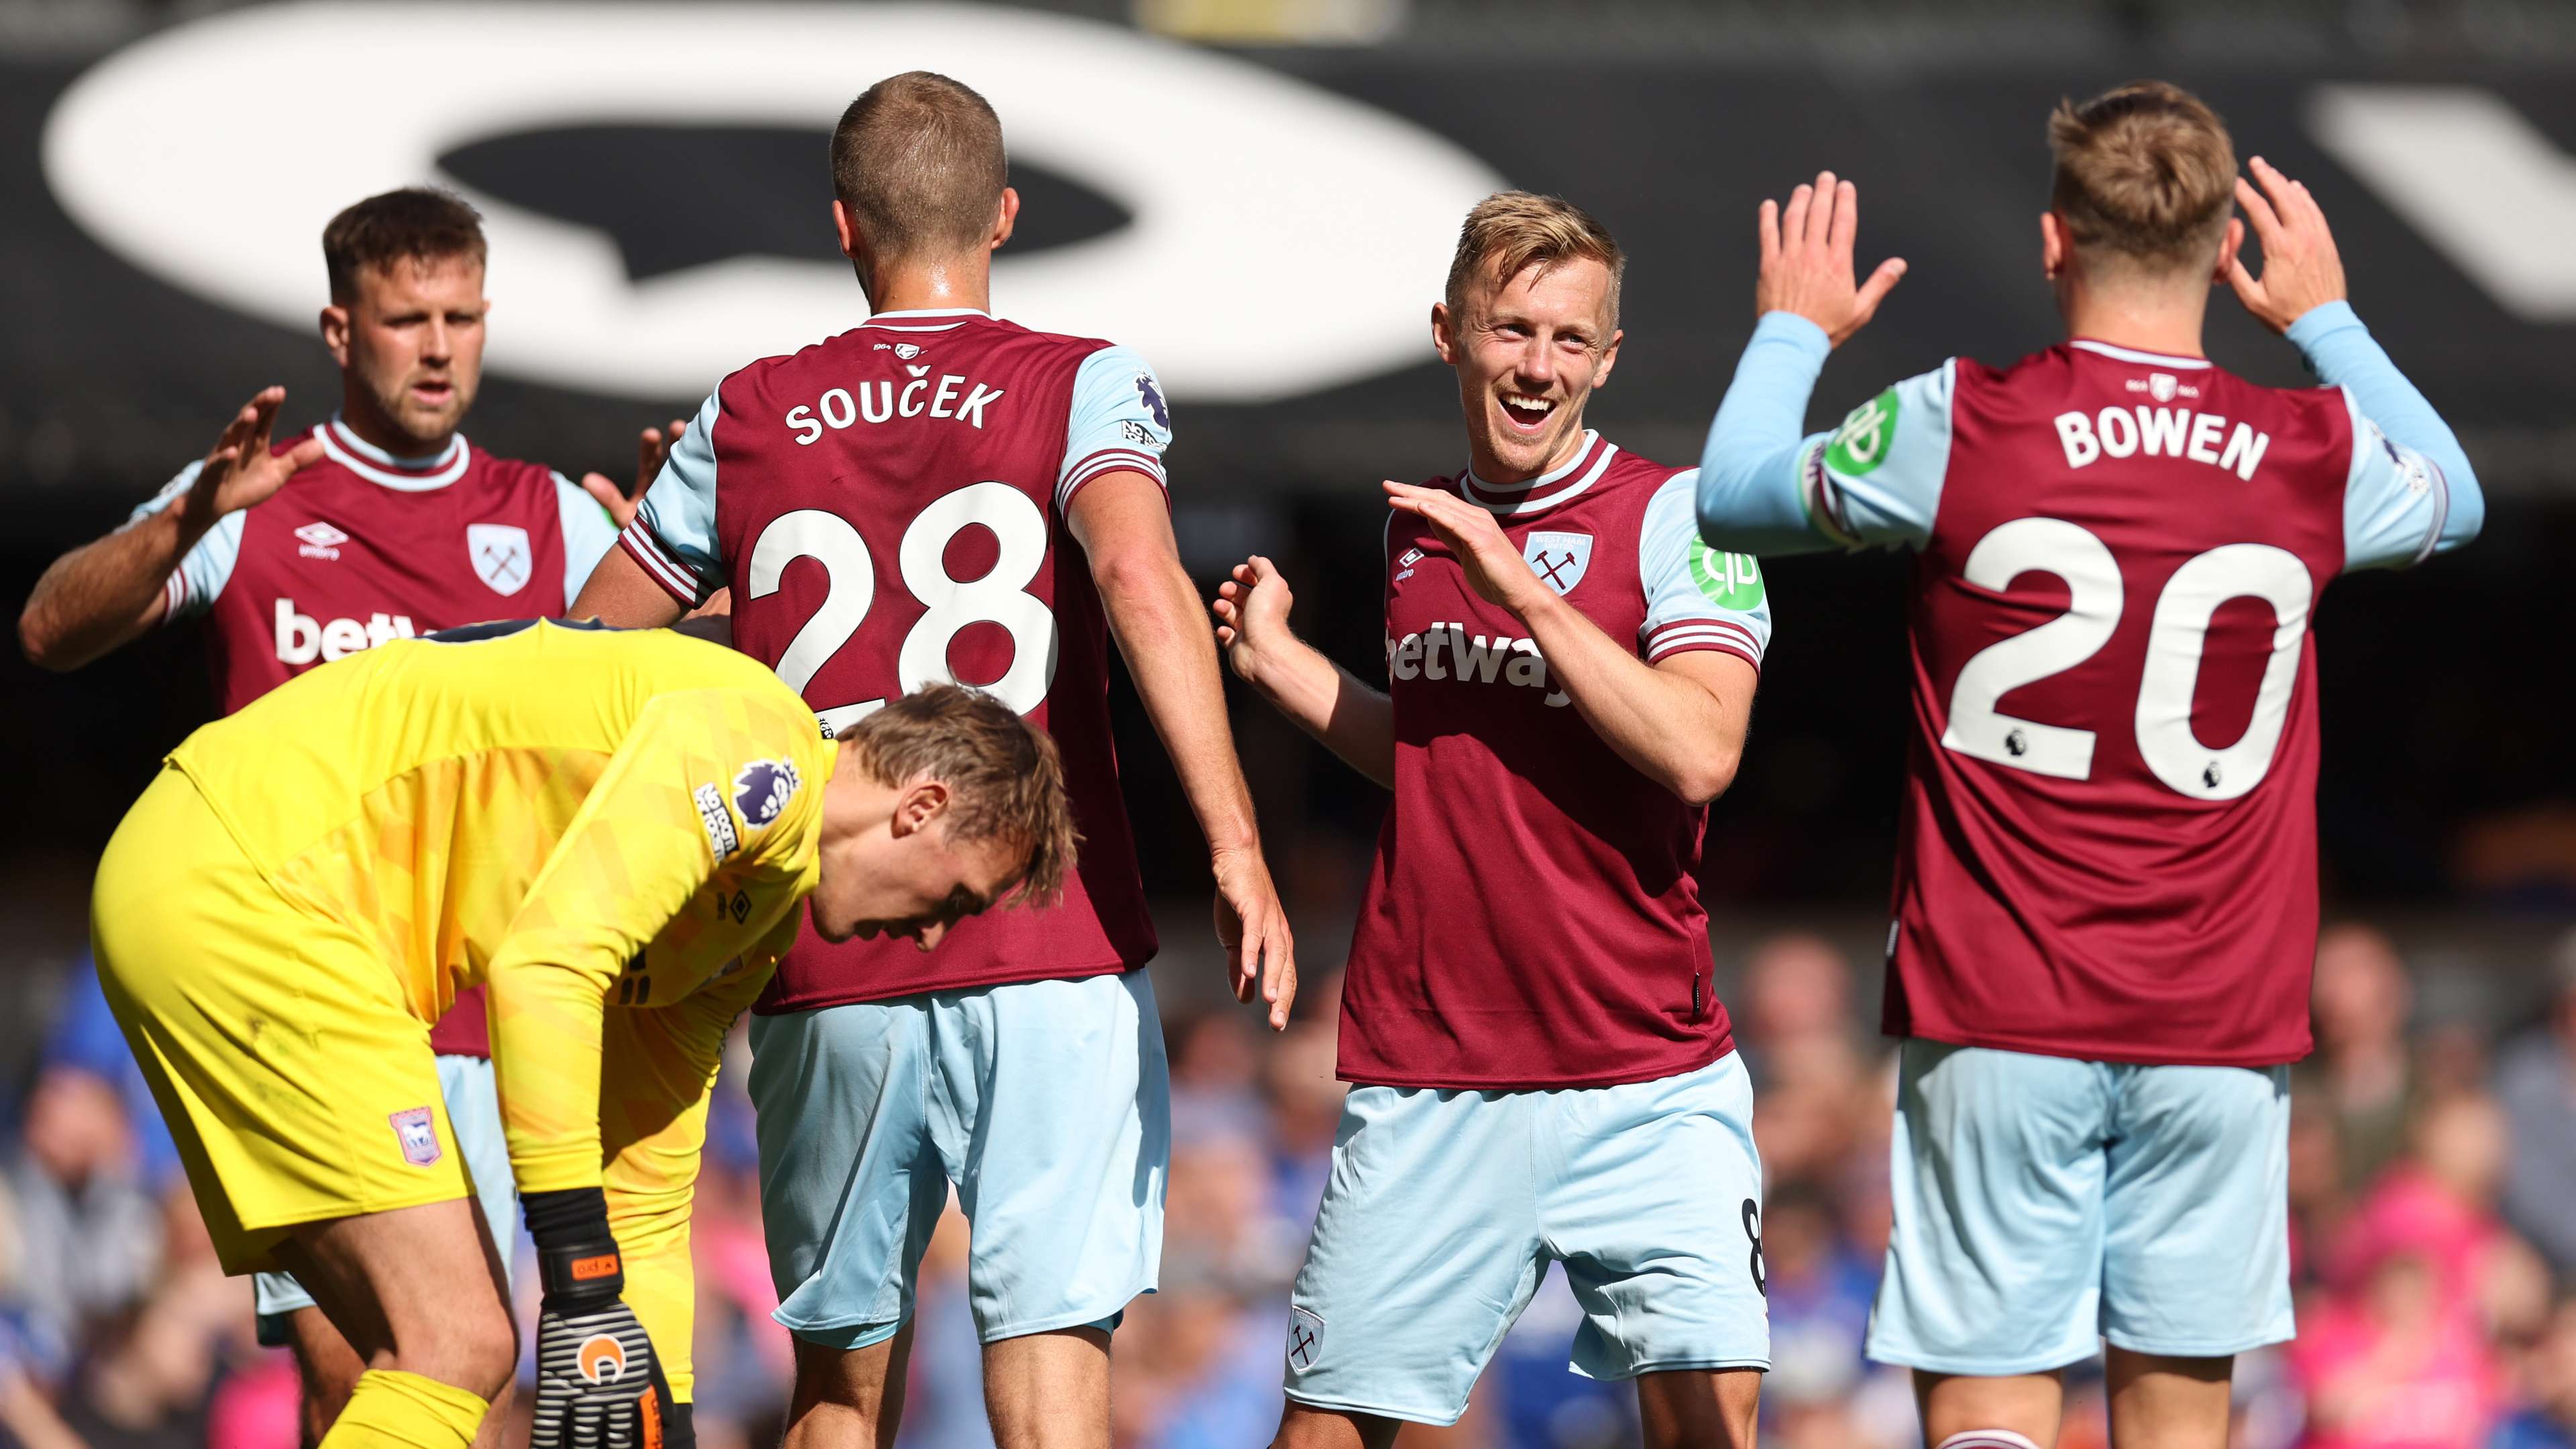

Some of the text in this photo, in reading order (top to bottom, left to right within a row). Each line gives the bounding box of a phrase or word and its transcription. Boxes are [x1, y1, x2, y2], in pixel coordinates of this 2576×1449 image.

[786, 364, 1004, 445] SOUČEK
[2054, 406, 2269, 482] BOWEN
[1564, 537, 1586, 546] HAM
[749, 480, 1059, 738] 28
[1941, 517, 2313, 801] 20
[1742, 1198, 1766, 1297] 8
